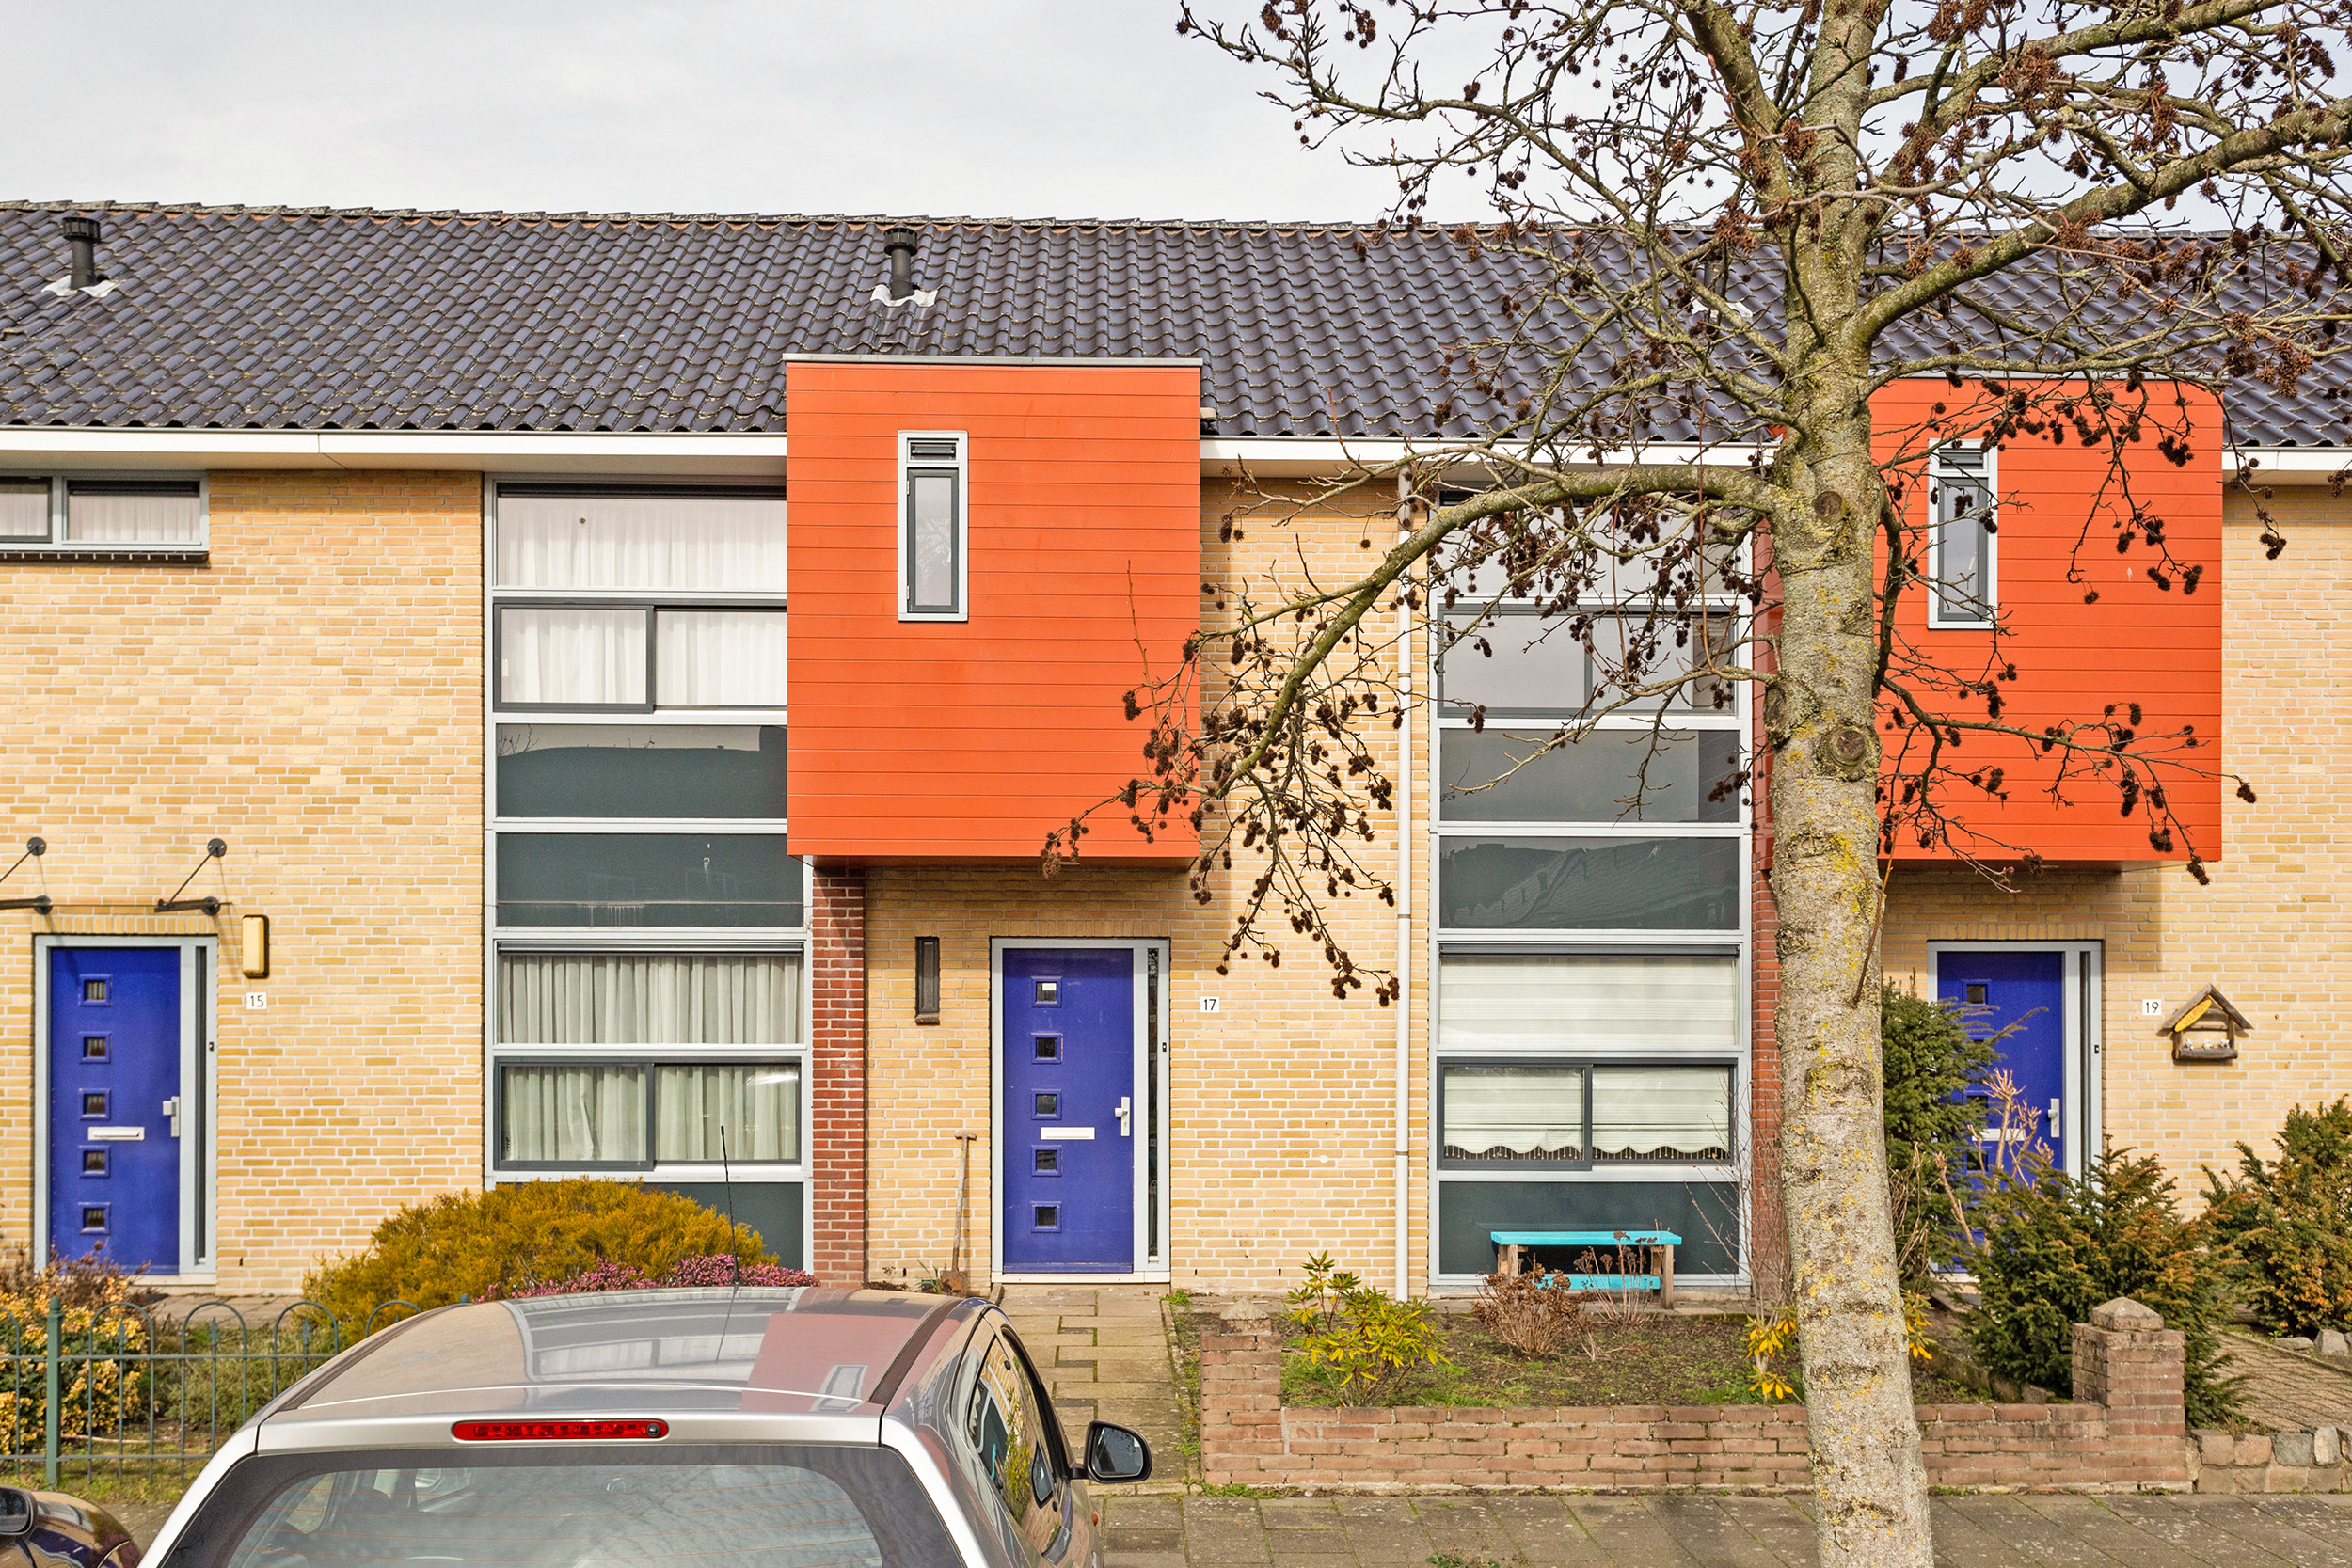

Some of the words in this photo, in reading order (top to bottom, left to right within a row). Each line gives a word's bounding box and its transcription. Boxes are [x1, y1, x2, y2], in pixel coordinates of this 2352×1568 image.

[250, 994, 264, 1007] 15
[1203, 998, 1216, 1011] 17
[2145, 1001, 2159, 1014] 19
